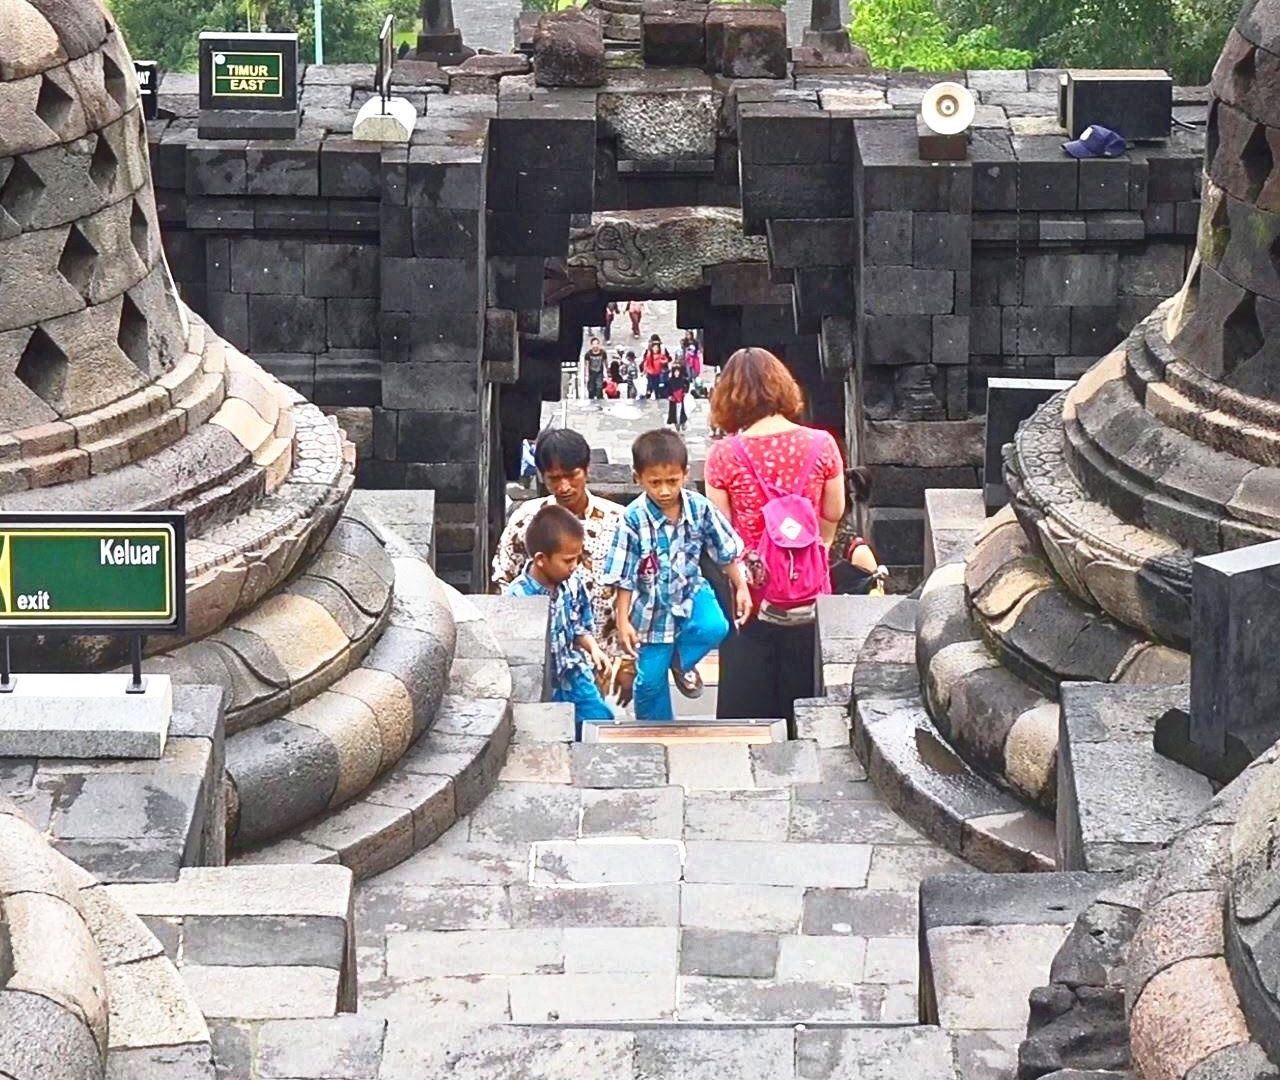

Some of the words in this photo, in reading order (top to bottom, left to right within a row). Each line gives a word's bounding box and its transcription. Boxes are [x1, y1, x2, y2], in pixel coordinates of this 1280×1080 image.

[227, 65, 268, 77] TIMUR
[230, 79, 266, 91] EAST
[100, 538, 160, 566] Keluar
[17, 591, 50, 610] exit
